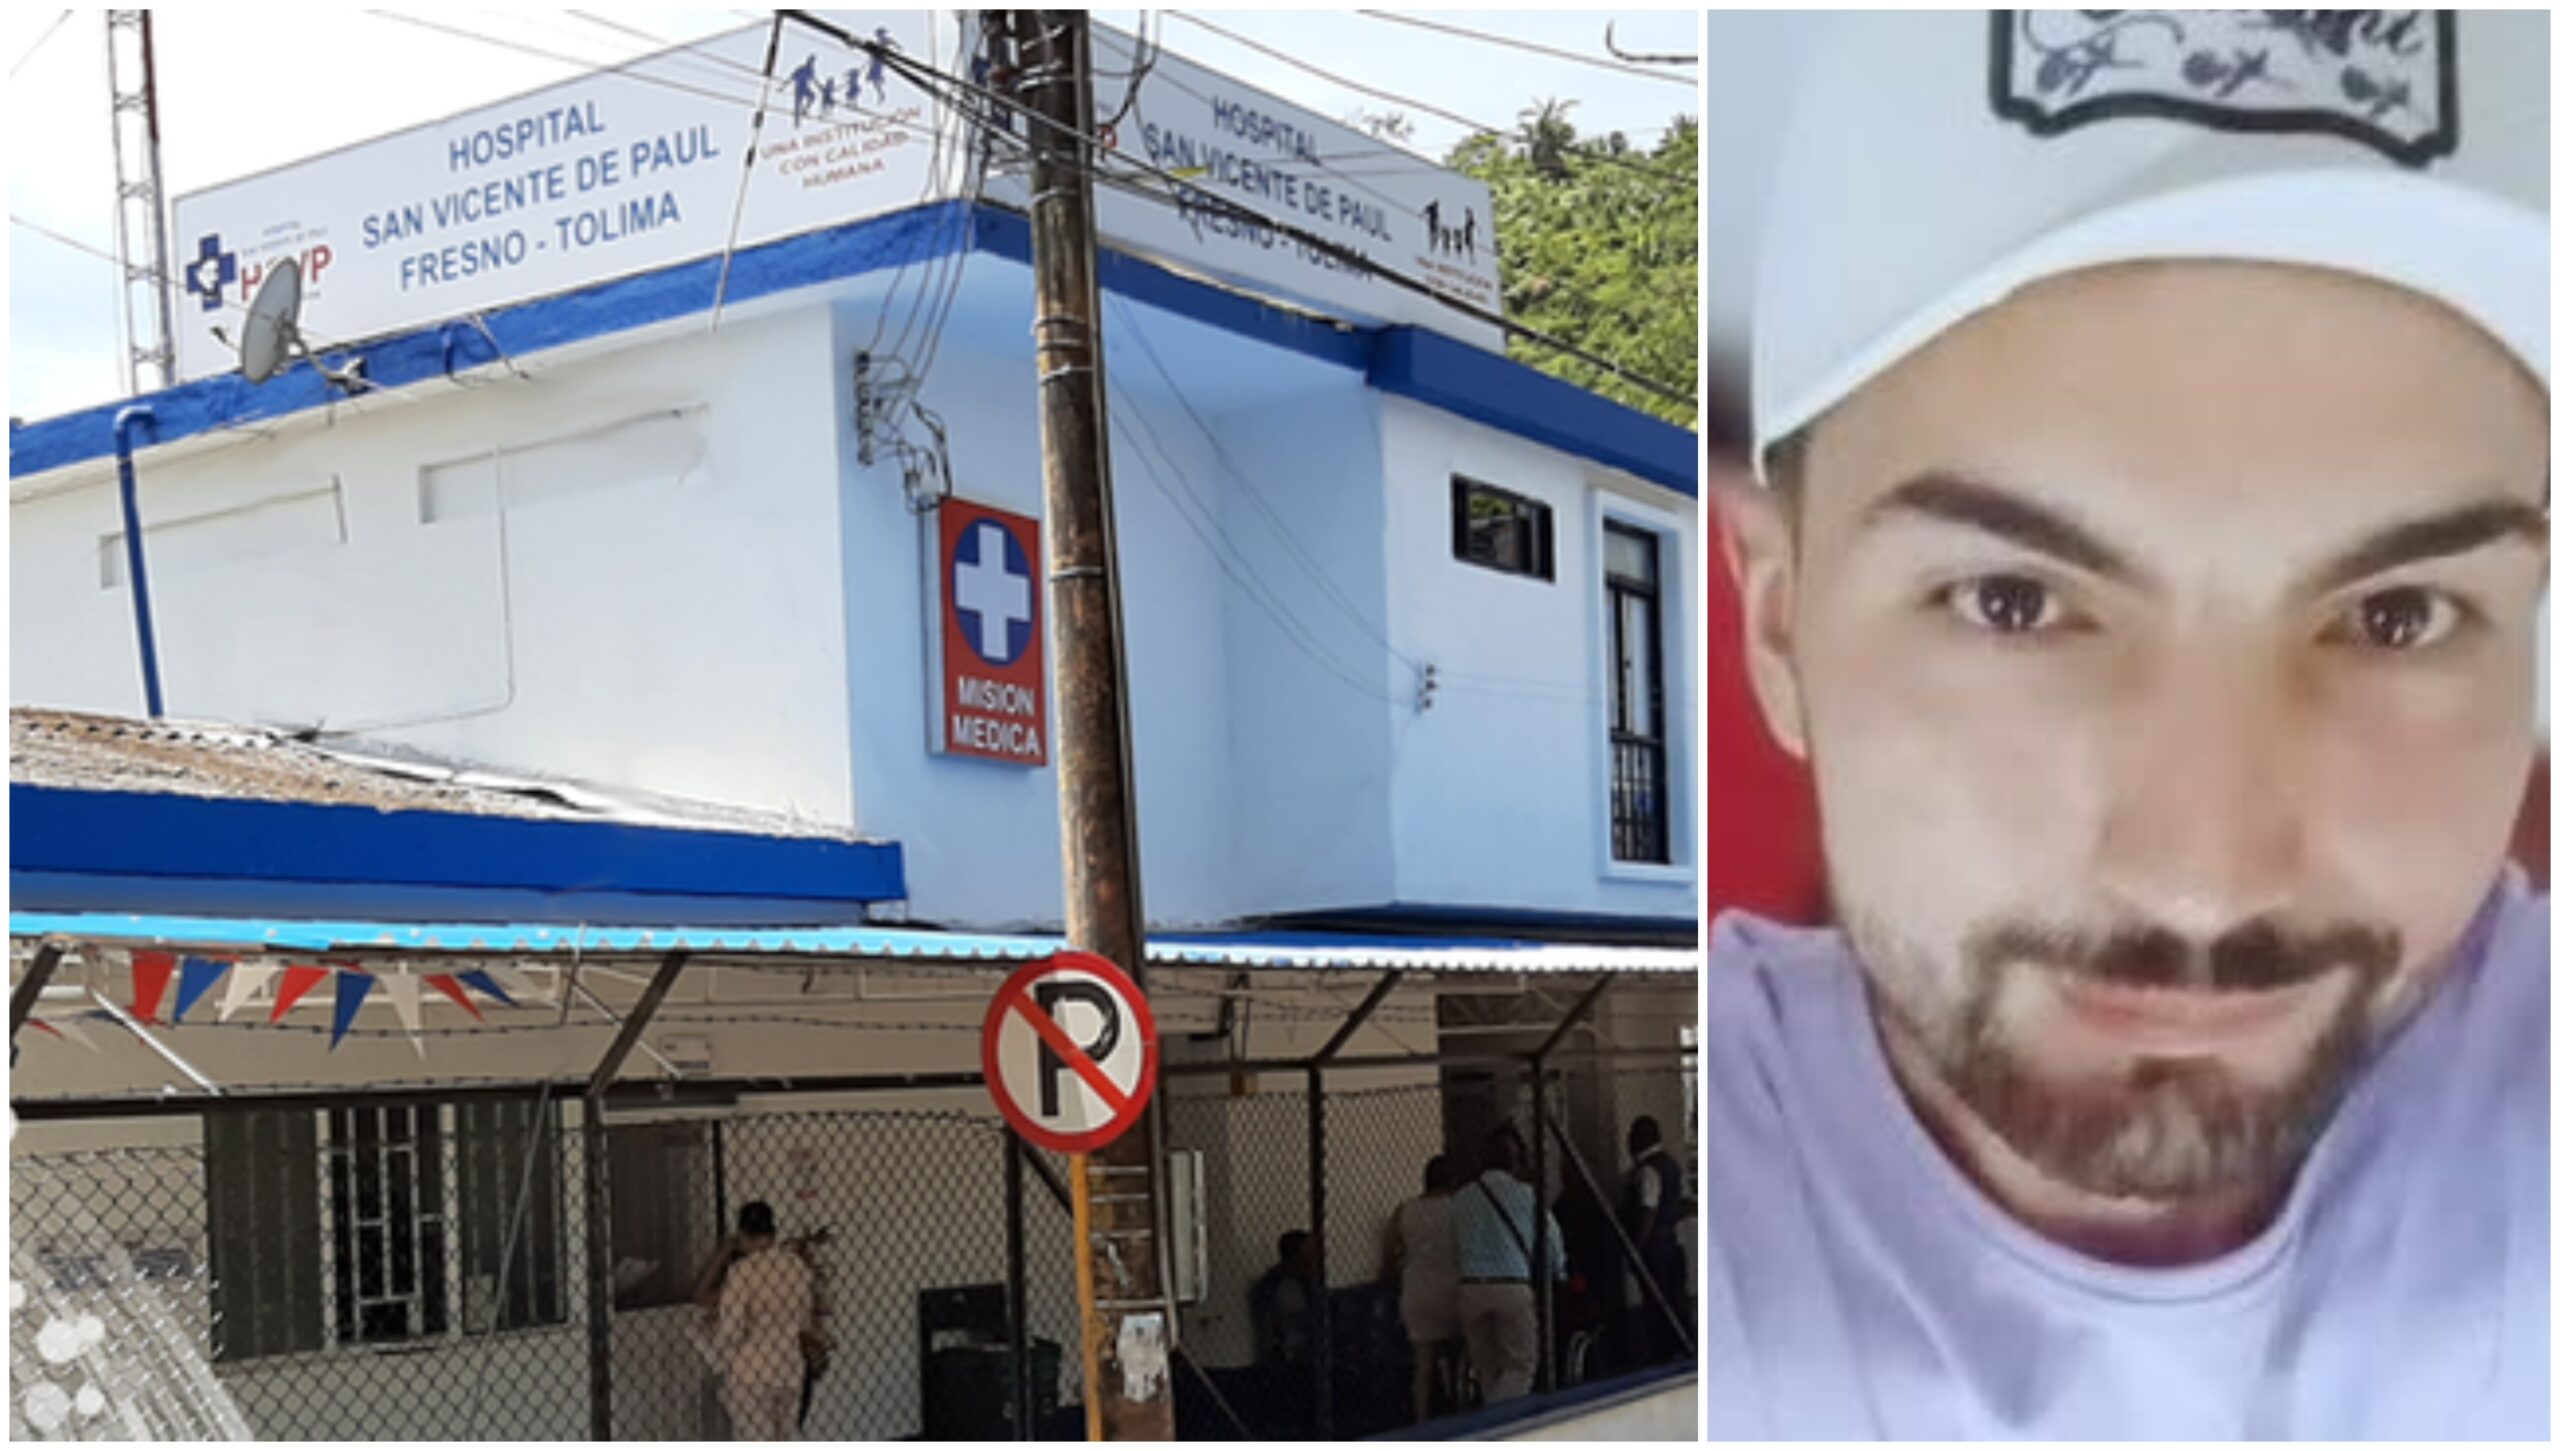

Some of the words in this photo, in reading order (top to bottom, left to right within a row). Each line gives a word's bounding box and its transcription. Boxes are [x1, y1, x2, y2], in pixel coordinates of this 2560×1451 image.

[449, 100, 605, 172] HOSPITAL
[761, 138, 799, 159] UNA
[1213, 96, 1320, 163] HOSPITAL
[362, 207, 424, 249] SAN
[431, 163, 565, 228] VICENTE
[577, 150, 619, 193] DE
[631, 124, 720, 178] PAUL
[779, 156, 819, 174] CON
[1143, 122, 1196, 169] SAN
[1200, 142, 1297, 209] VICENTE
[1304, 181, 1334, 221] DE
[1340, 194, 1392, 241] PAUL
[400, 228, 527, 291] FRESNO
[555, 190, 681, 251] TOLIMA
[958, 675, 1035, 716] MISION
[953, 714, 1041, 756] MEDICA
[1035, 980, 1121, 1117] P
